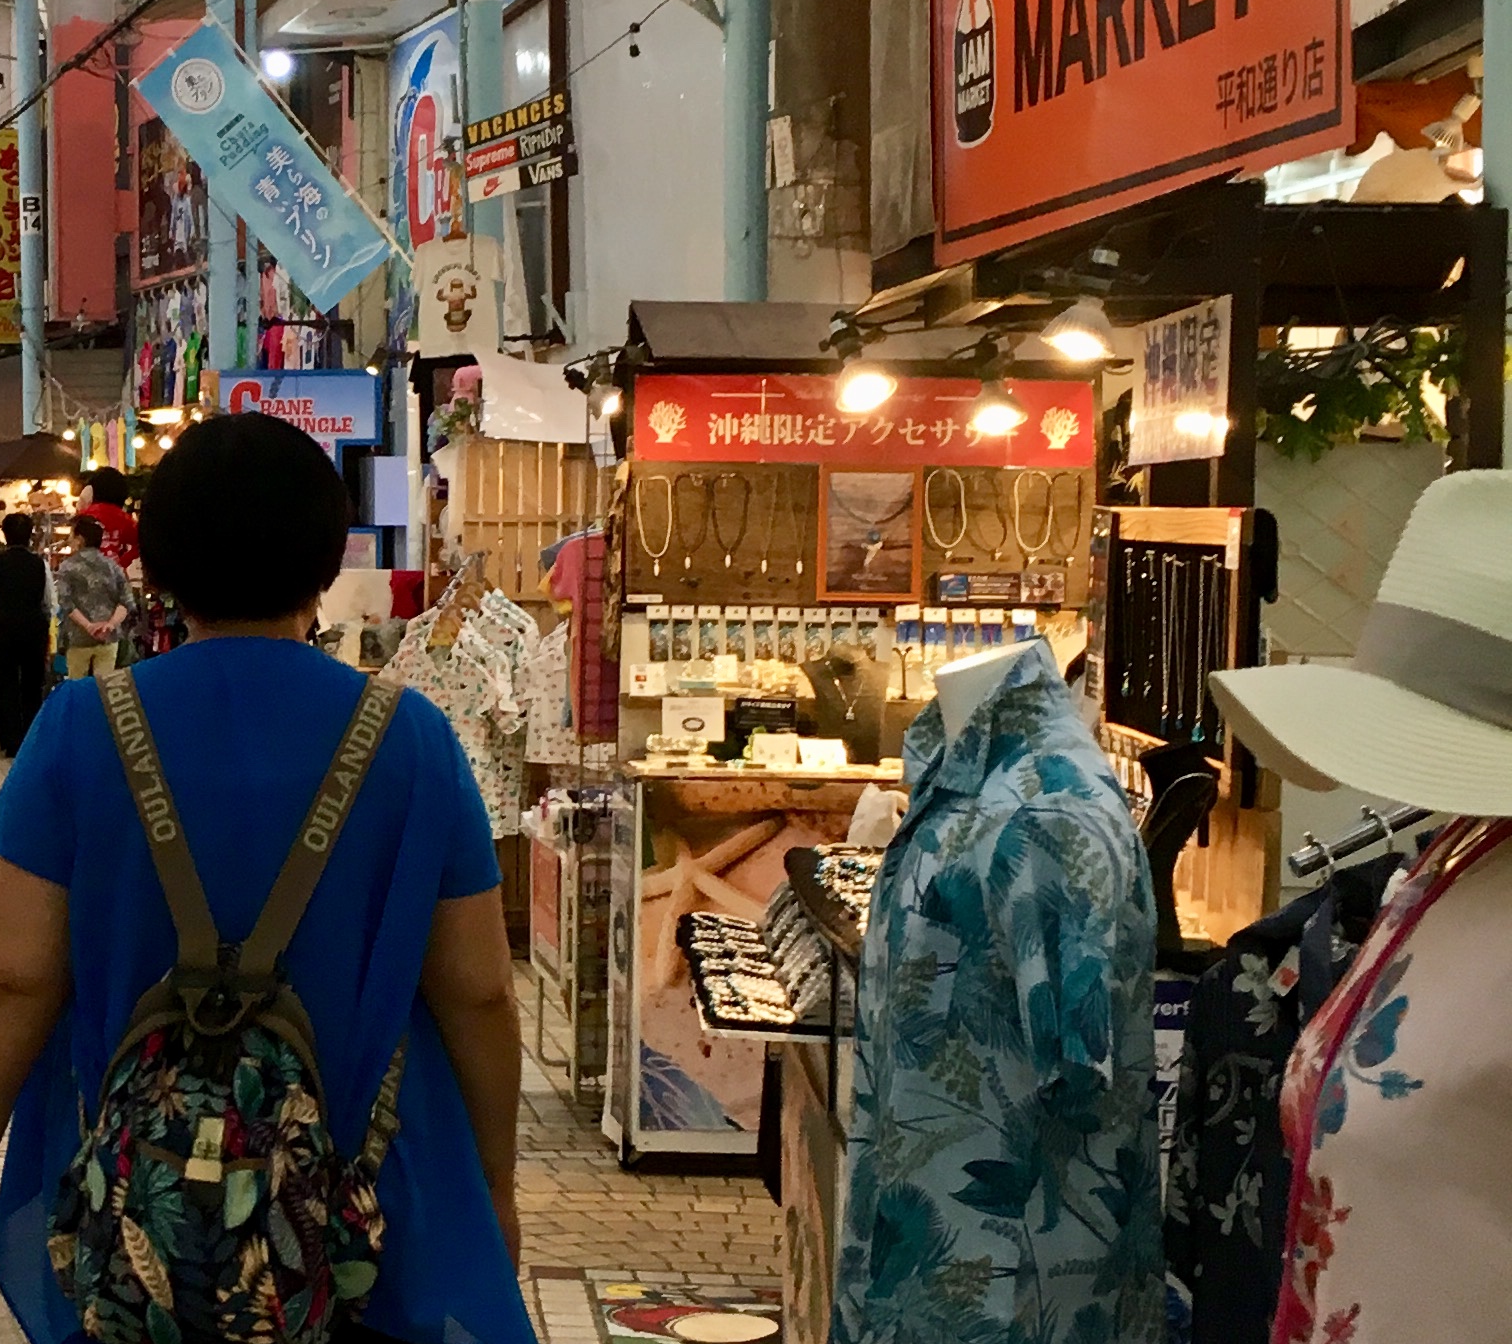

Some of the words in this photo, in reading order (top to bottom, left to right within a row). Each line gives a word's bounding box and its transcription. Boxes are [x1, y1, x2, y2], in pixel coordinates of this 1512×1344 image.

[1216, 36, 1325, 130] 平和通り店
[467, 93, 565, 145] VACANCES
[219, 122, 269, 167] Pudding
[466, 144, 516, 173] Supreme
[266, 145, 329, 221] 美ら海の
[528, 156, 564, 185] VANS
[22, 197, 40, 213] B
[255, 174, 331, 269] 青いプリン
[23, 215, 41, 232] 14
[229, 381, 314, 417] CRANE
[288, 416, 353, 433] UNGLE
